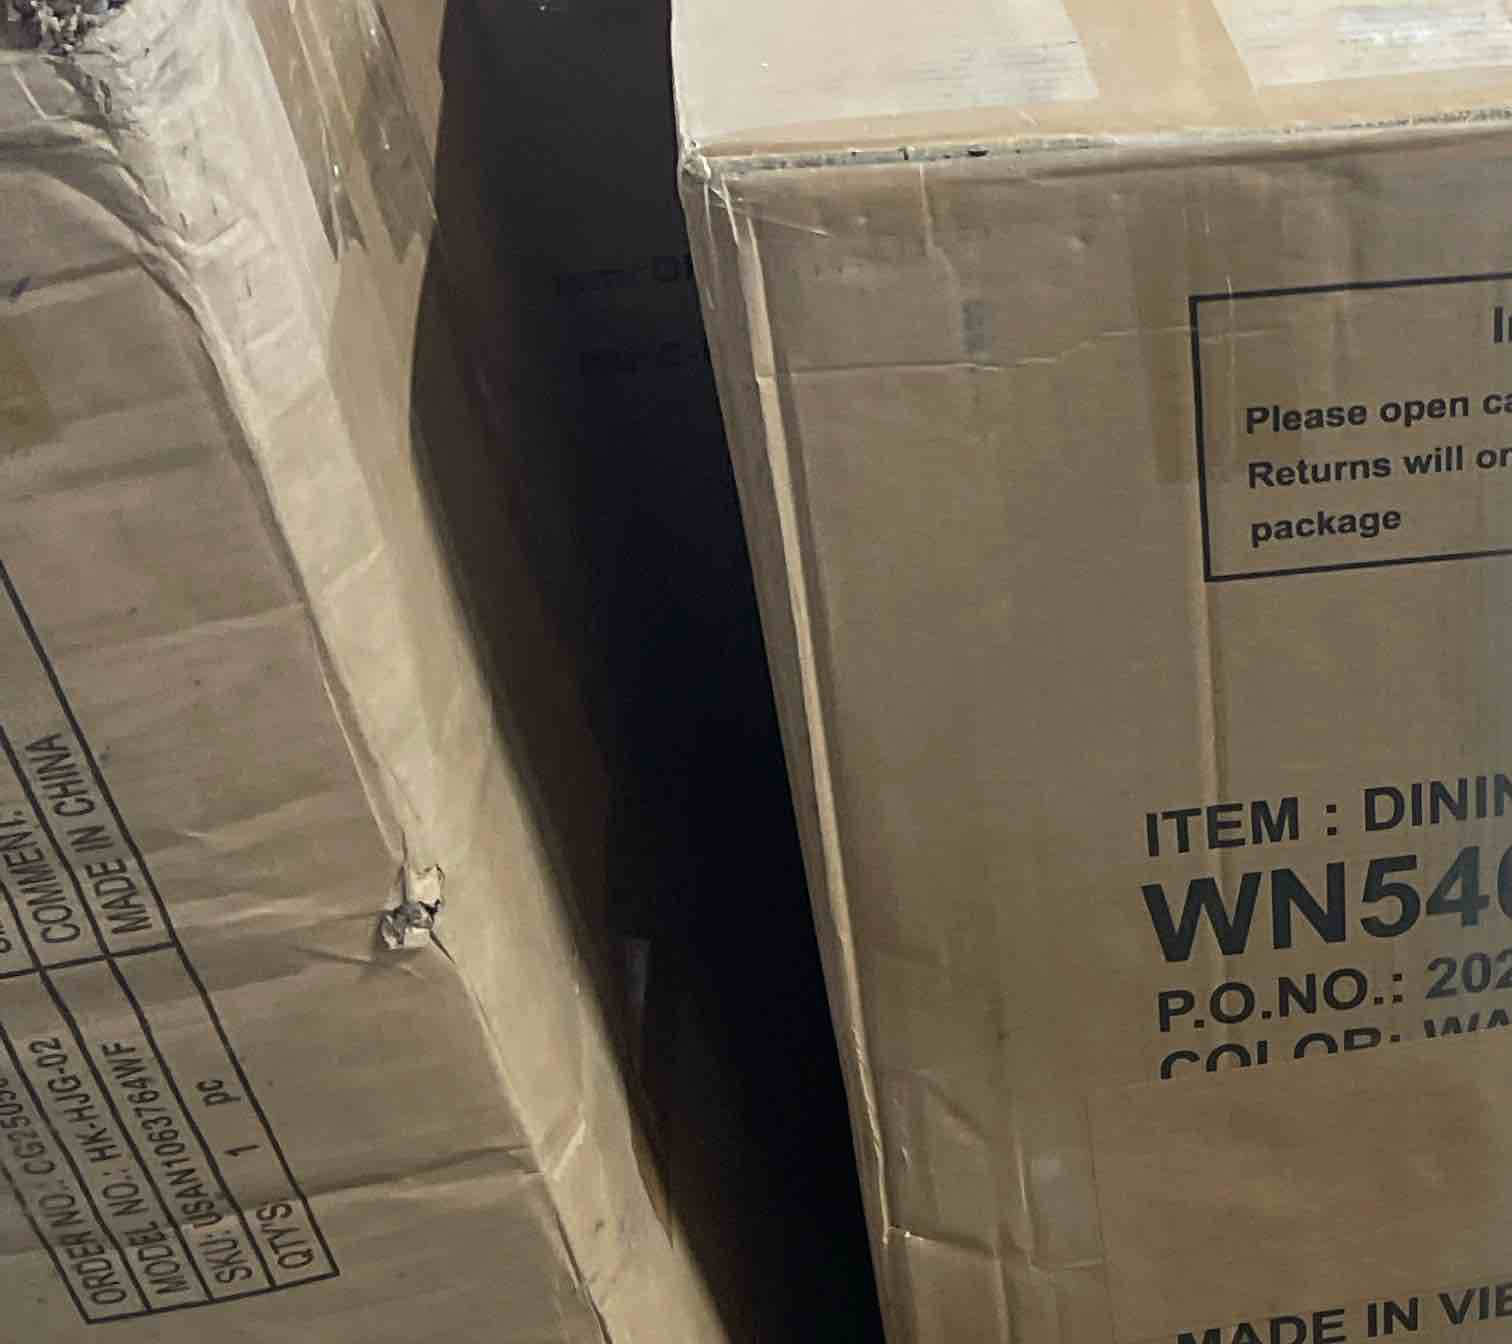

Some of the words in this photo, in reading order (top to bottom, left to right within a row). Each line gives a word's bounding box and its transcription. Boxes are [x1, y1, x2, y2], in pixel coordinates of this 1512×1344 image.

[1246, 398, 1368, 435] Please
[1379, 392, 1470, 428] open
[1248, 450, 1392, 490] Returns
[1404, 443, 1465, 477] will
[1250, 506, 1401, 549] package
[24, 732, 96, 818] CHINA
[66, 825, 115, 853] IN
[1144, 796, 1301, 857] ITEM
[84, 857, 153, 935] MADE
[1158, 966, 1404, 1033] P.O.NO.:
[28, 1036, 121, 1164] HK-HJG-02
[196, 1079, 242, 1107] pc
[101, 1041, 224, 1229] USAN1063764WF
[224, 1143, 261, 1158] 1
[58, 1230, 127, 1306] ORDER
[124, 1220, 191, 1295] MODEL
[200, 1229, 253, 1284] SKU:
[1367, 1296, 1421, 1340] IN
